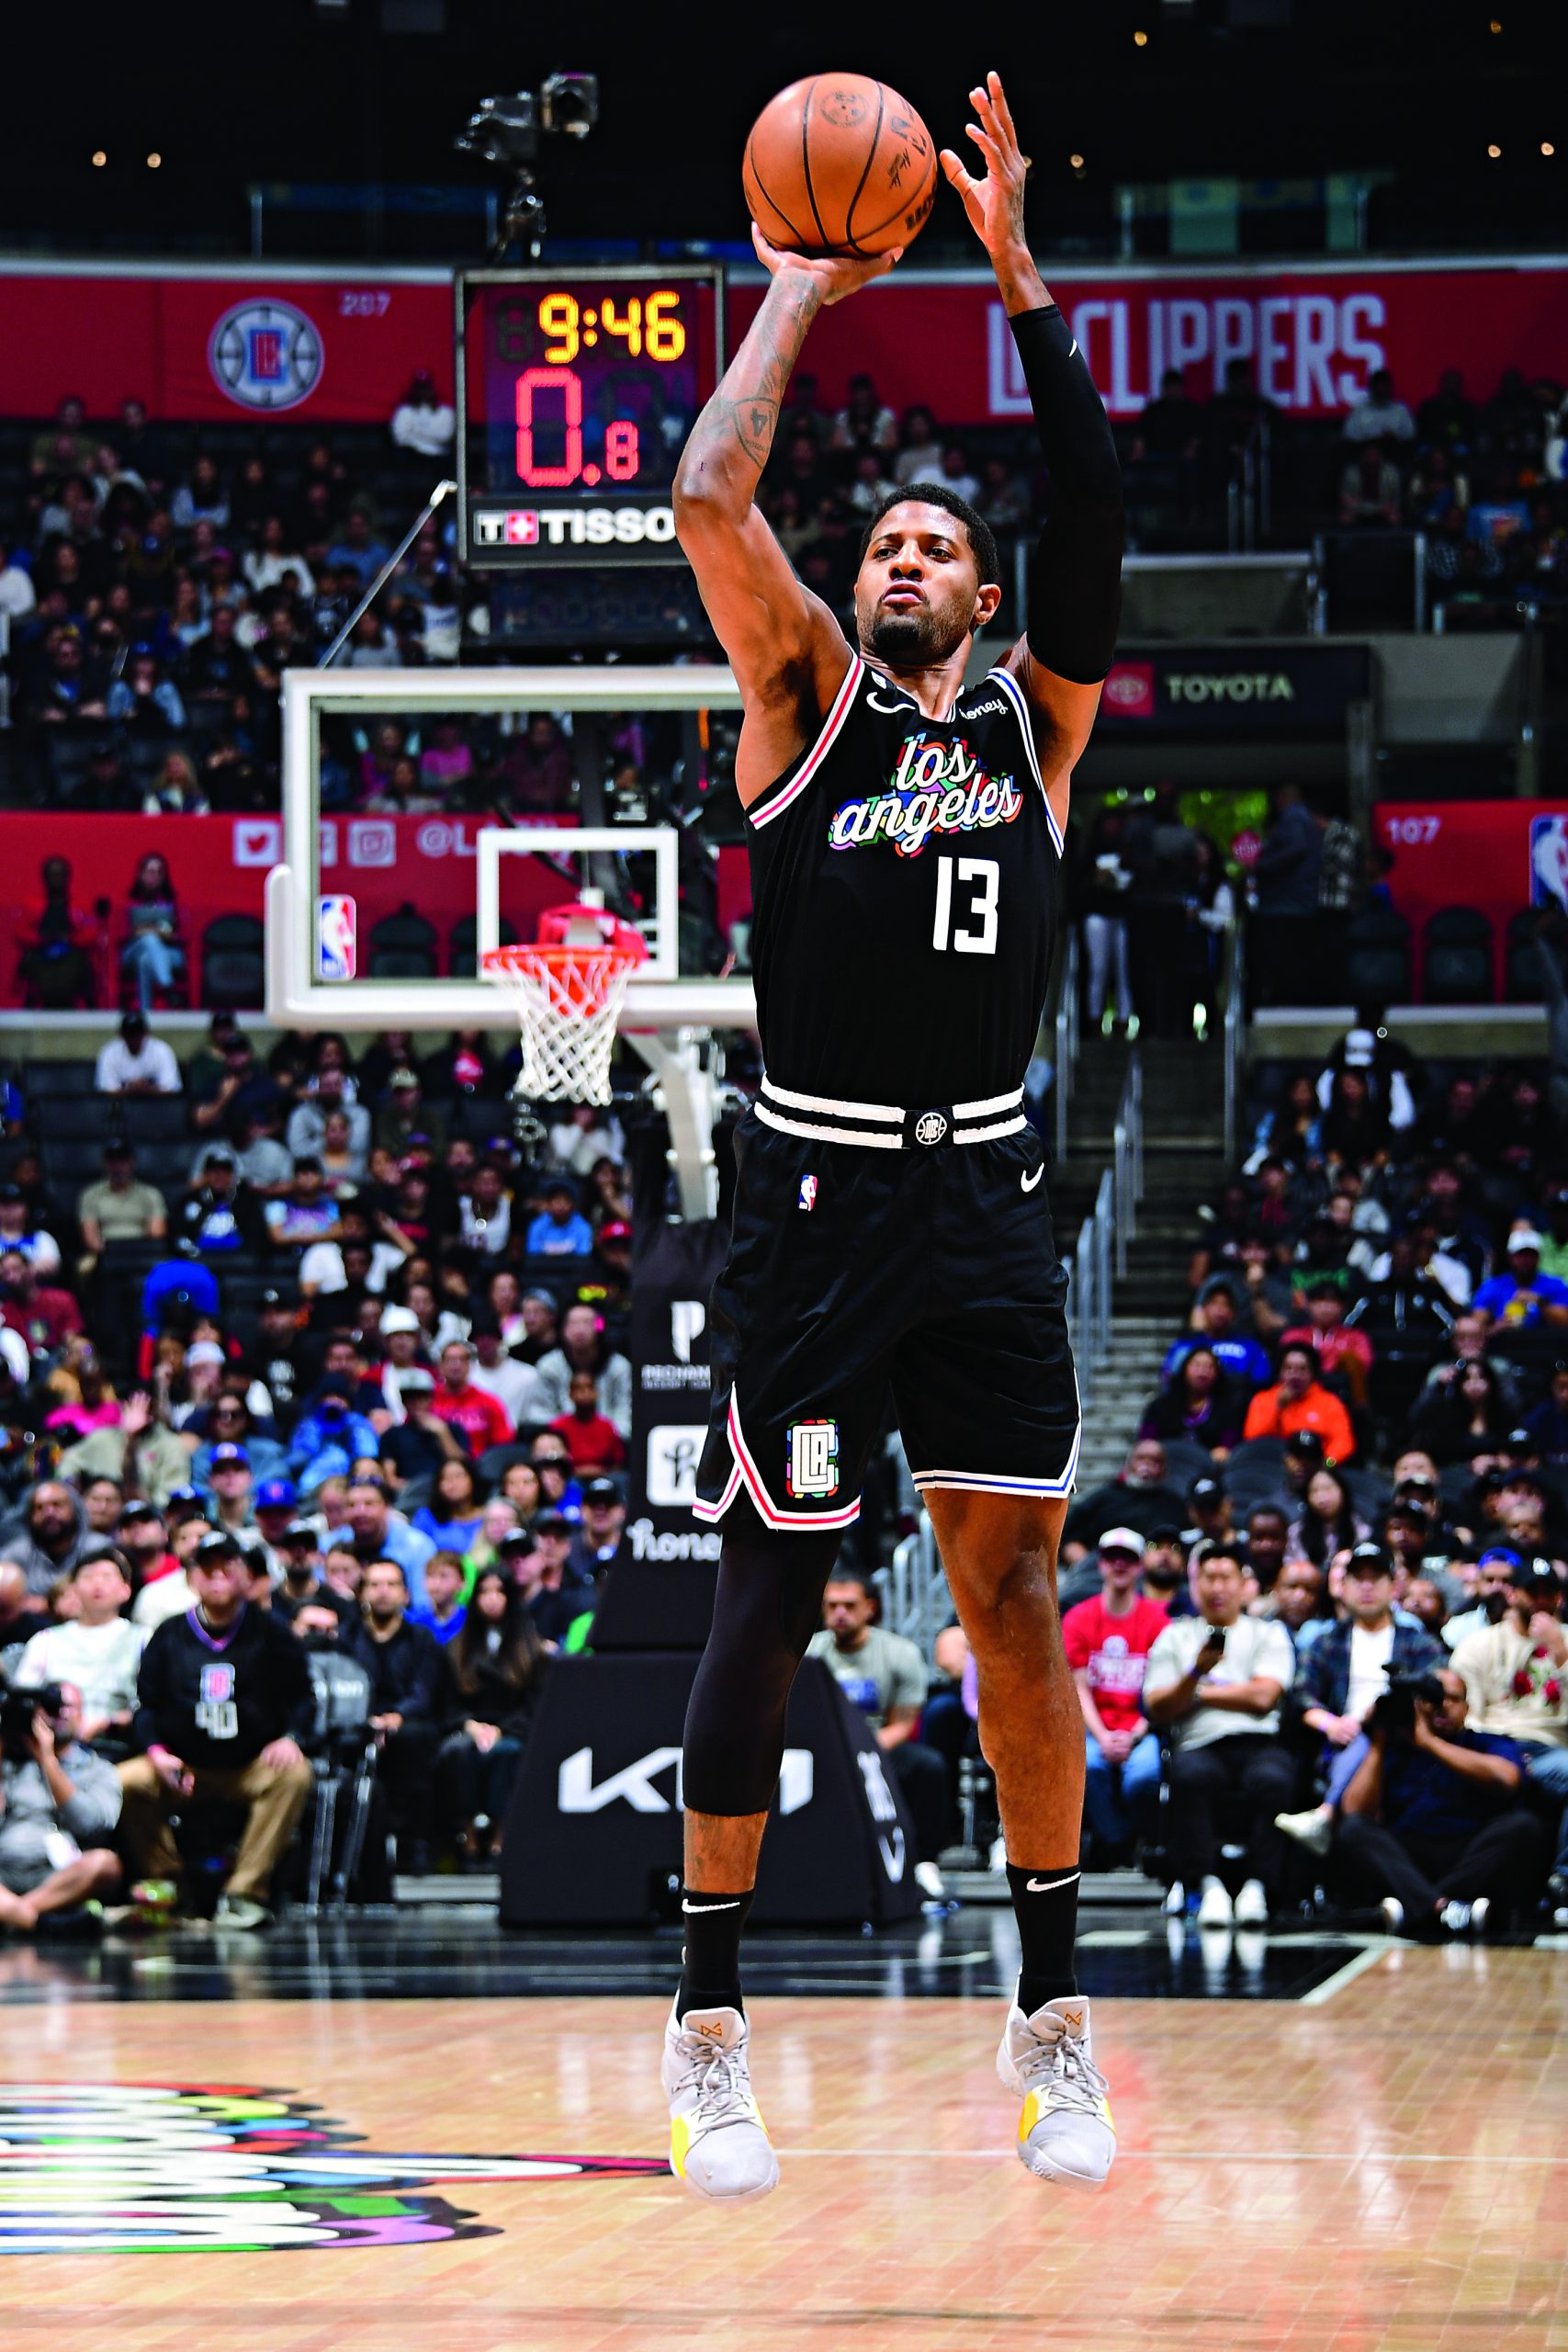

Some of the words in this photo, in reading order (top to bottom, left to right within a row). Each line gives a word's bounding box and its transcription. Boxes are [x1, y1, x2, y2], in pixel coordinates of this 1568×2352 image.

[539, 290, 685, 364] 9:46
[1072, 293, 1385, 412] CLIPPERS
[515, 368, 639, 487] 0.8
[539, 507, 677, 544] TISSO
[1168, 673, 1292, 703] TOYOTA
[896, 740, 976, 792] los
[832, 772, 1021, 854] angeles
[1386, 815, 1440, 845] 107
[933, 855, 999, 955] 13
